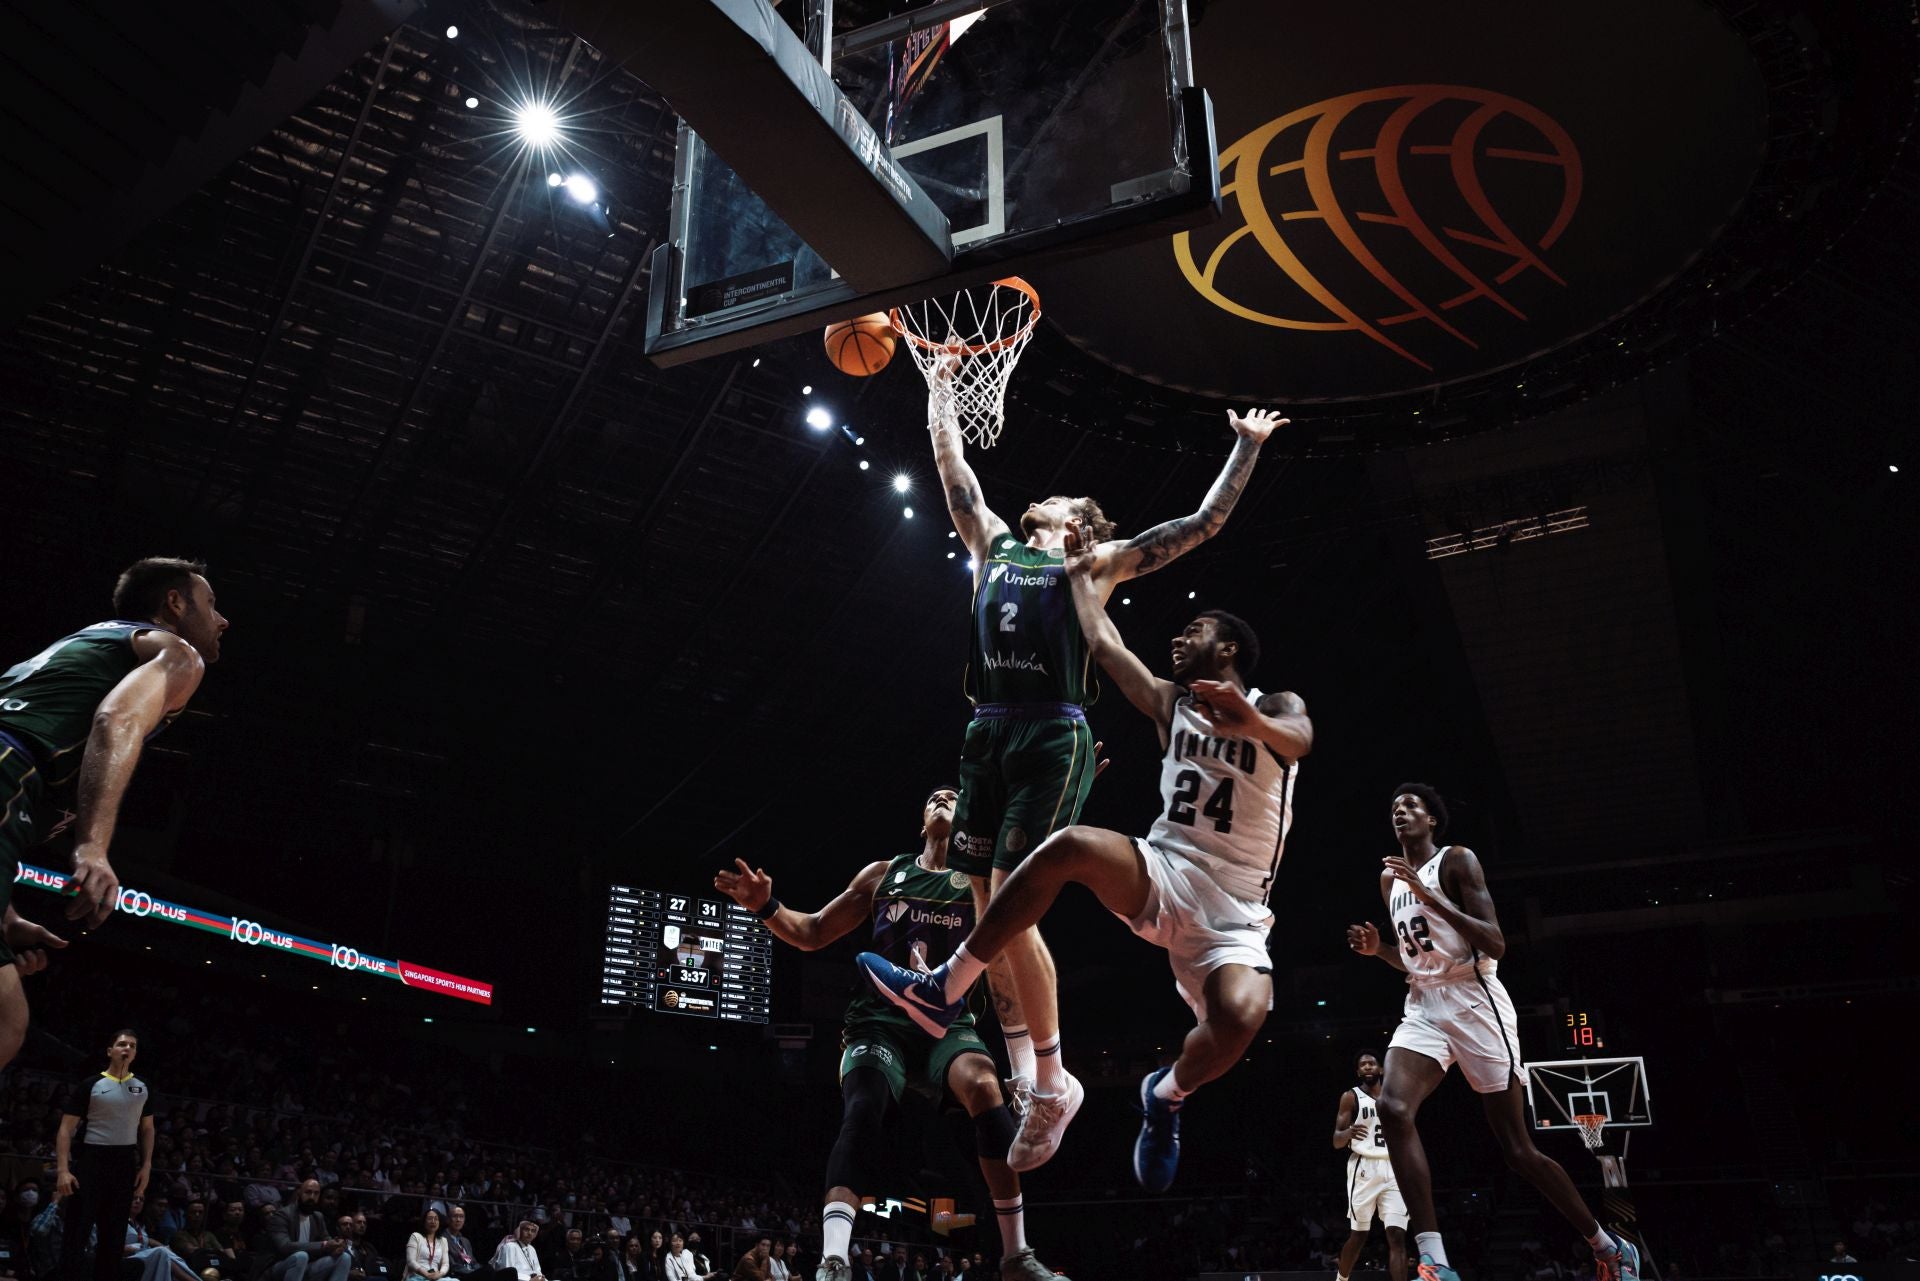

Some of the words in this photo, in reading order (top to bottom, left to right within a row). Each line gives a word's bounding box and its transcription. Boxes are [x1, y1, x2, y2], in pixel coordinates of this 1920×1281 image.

[723, 276, 787, 299] INTERCONTINENTAL
[723, 298, 737, 307] CUP
[1004, 572, 1058, 589] Unicaja
[1000, 602, 1019, 632] 2
[1174, 729, 1257, 775] UNITED
[1167, 769, 1235, 834] 24
[23, 868, 65, 889] PLUS
[114, 886, 152, 917] 100
[152, 902, 187, 921] PLUS
[670, 898, 686, 911] 27
[702, 903, 716, 916] 31
[910, 909, 963, 930] Unicaja
[230, 916, 263, 945] 100
[262, 931, 293, 949] PLUS
[1397, 915, 1434, 958] 32
[330, 943, 359, 970] 100
[359, 956, 386, 973] PLUS
[404, 969, 435, 984] SINGAPORE
[435, 978, 455, 989] SPORTS
[455, 983, 467, 991] HUB
[466, 986, 491, 998] PARTNERS
[680, 969, 707, 984] 3:37
[1573, 1027, 1594, 1046] 18
